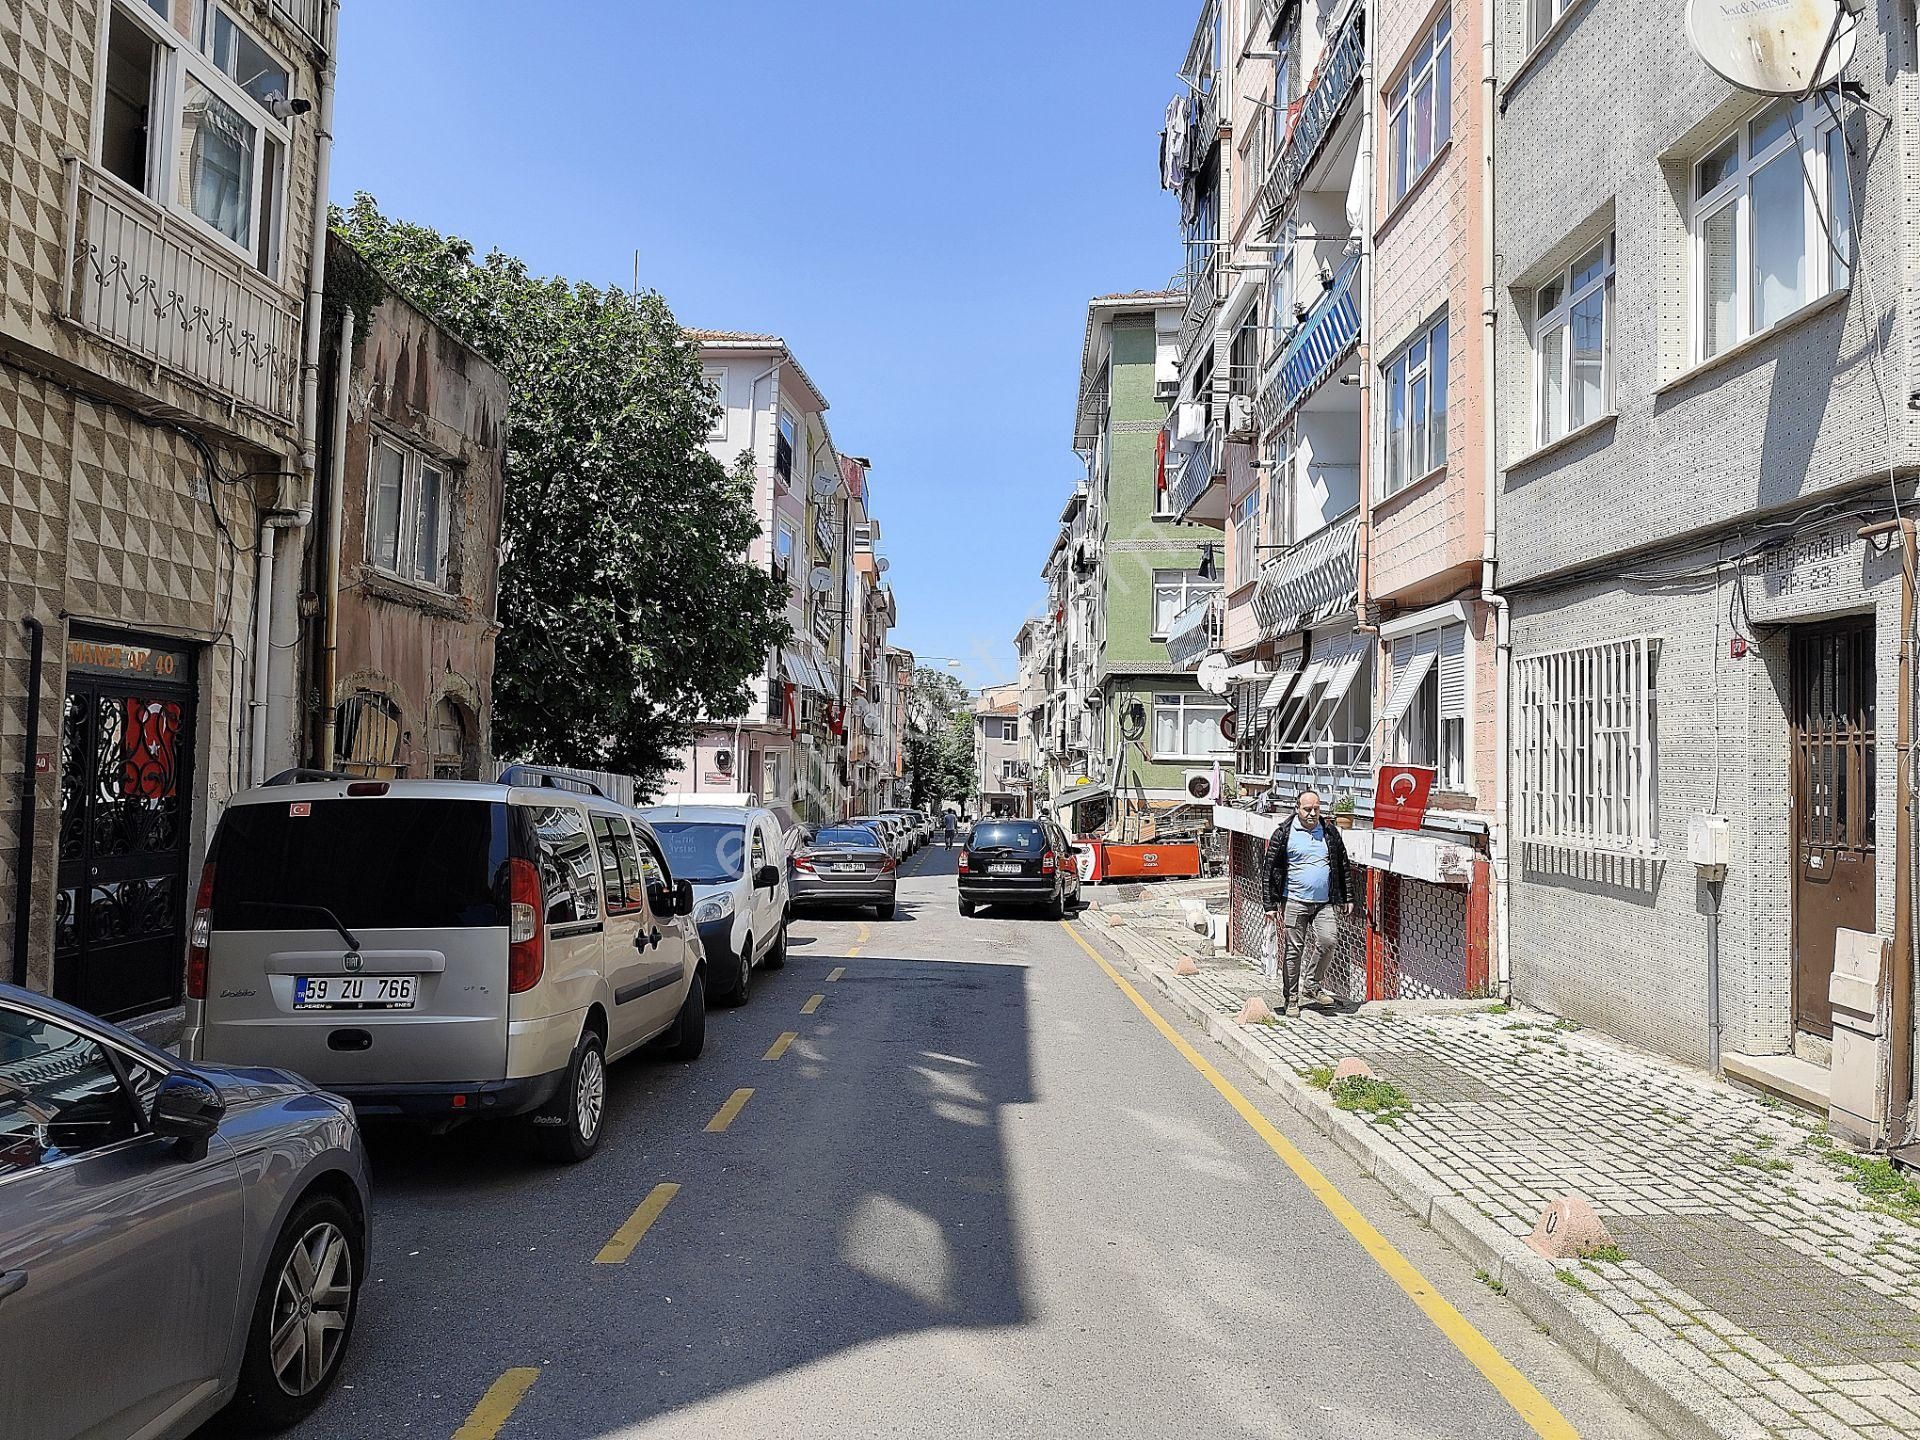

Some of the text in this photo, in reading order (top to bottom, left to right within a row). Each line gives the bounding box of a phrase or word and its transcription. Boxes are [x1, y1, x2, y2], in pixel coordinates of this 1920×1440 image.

[1809, 565, 1833, 591] 23
[155, 655, 175, 674] 40
[345, 957, 359, 969] FIAT
[306, 979, 411, 999] 59 ZU 766
